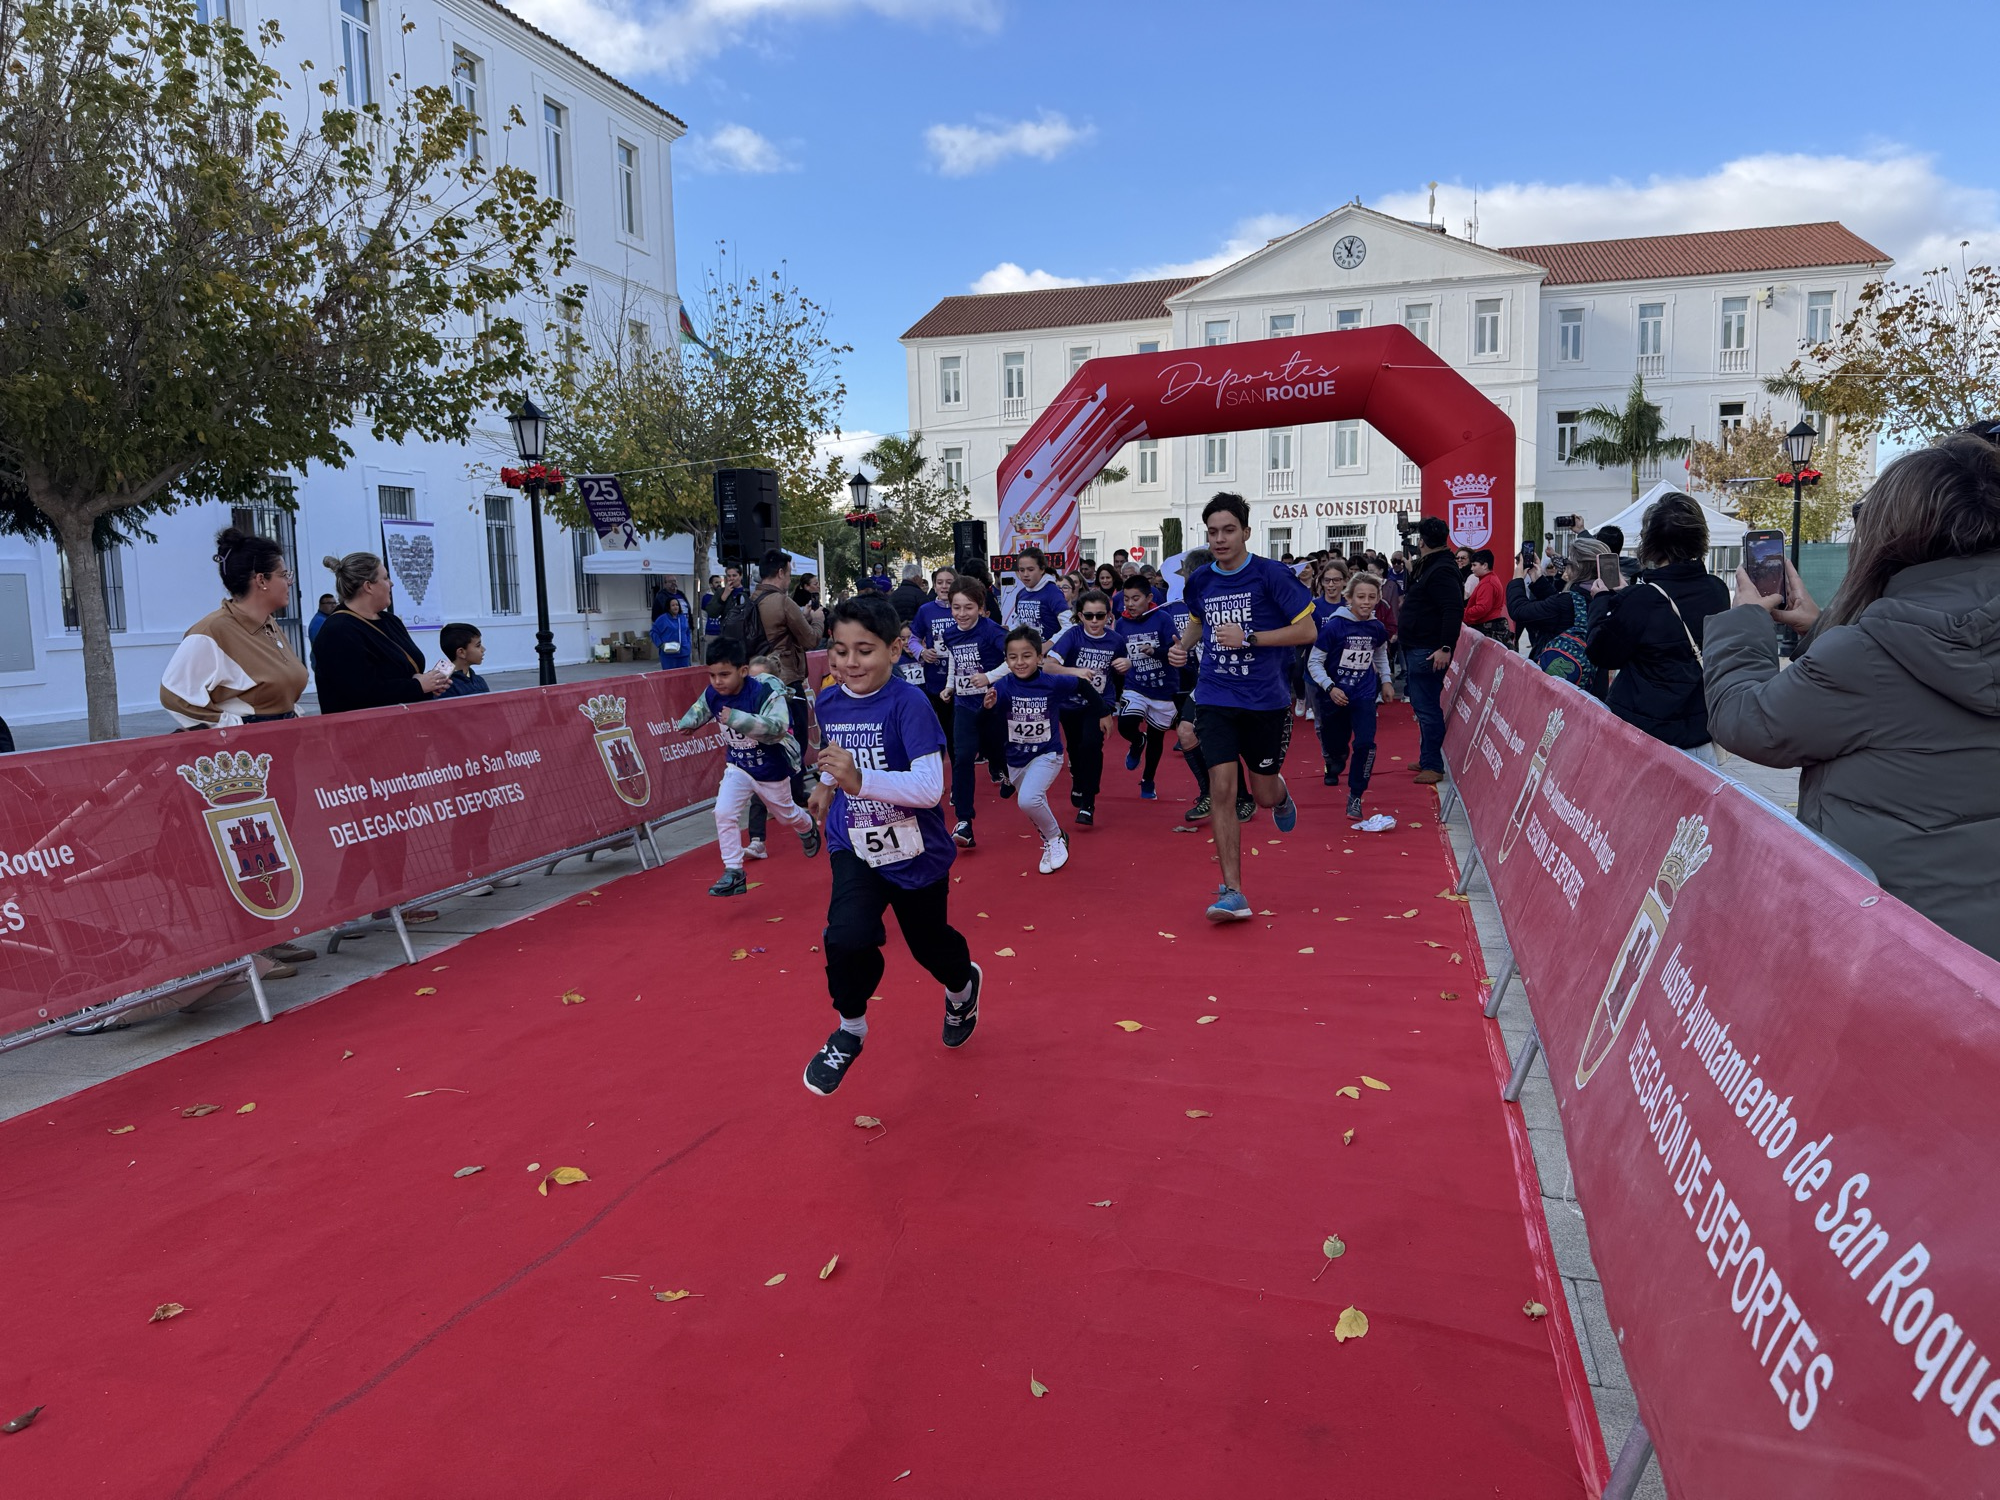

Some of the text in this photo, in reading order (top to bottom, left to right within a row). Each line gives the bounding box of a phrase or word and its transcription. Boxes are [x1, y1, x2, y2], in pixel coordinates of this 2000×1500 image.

[1158, 350, 1340, 409] Deportes
[584, 481, 618, 501] 25
[1273, 498, 1421, 519] CASA CONSISTORIAL
[1205, 599, 1251, 612] SAN ROQUE
[1229, 592, 1251, 600] POPULAR
[1206, 608, 1252, 626] CORRE
[1347, 652, 1371, 663] 412
[831, 723, 855, 732] CARRERA
[1014, 723, 1044, 737] 428
[845, 732, 884, 747] ROQUE
[314, 750, 541, 809] Ilustre Ayuntamiento de San Roque
[329, 782, 525, 848] DELEGACIÓN DE DEPORTES
[866, 826, 900, 852] 51
[0, 844, 75, 878] Roque
[1542, 841, 1560, 873] DE
[1660, 942, 2000, 1446] Ilustre Ayuntamiento de San Roque
[1628, 1019, 1834, 1431] DELEGACIÓN DE DEPORTES
